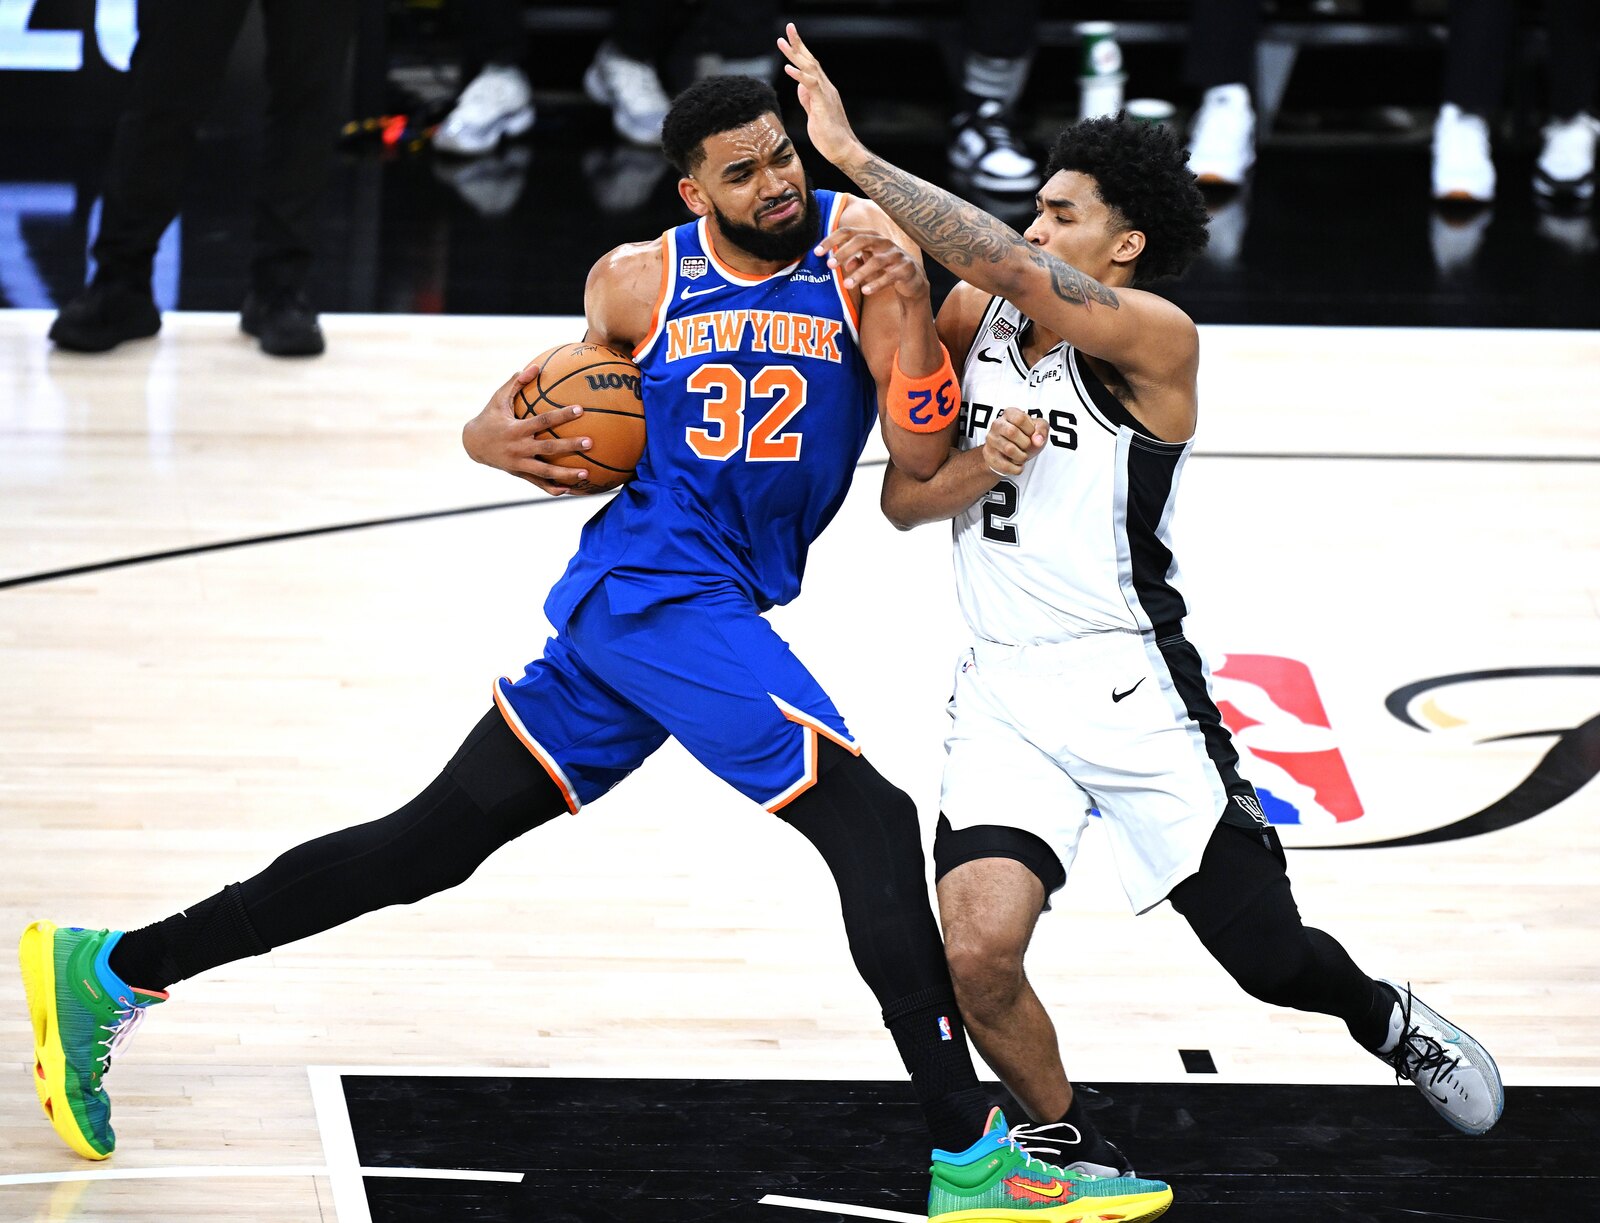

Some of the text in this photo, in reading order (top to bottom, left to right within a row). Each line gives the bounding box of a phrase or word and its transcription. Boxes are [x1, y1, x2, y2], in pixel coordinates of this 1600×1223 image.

[665, 309, 842, 364] NEW YORK
[998, 318, 1014, 333] USA
[584, 372, 642, 401] lson
[908, 379, 956, 425] 32
[685, 363, 808, 462] 32
[960, 401, 1078, 451] SPS
[981, 479, 1020, 547] 2
